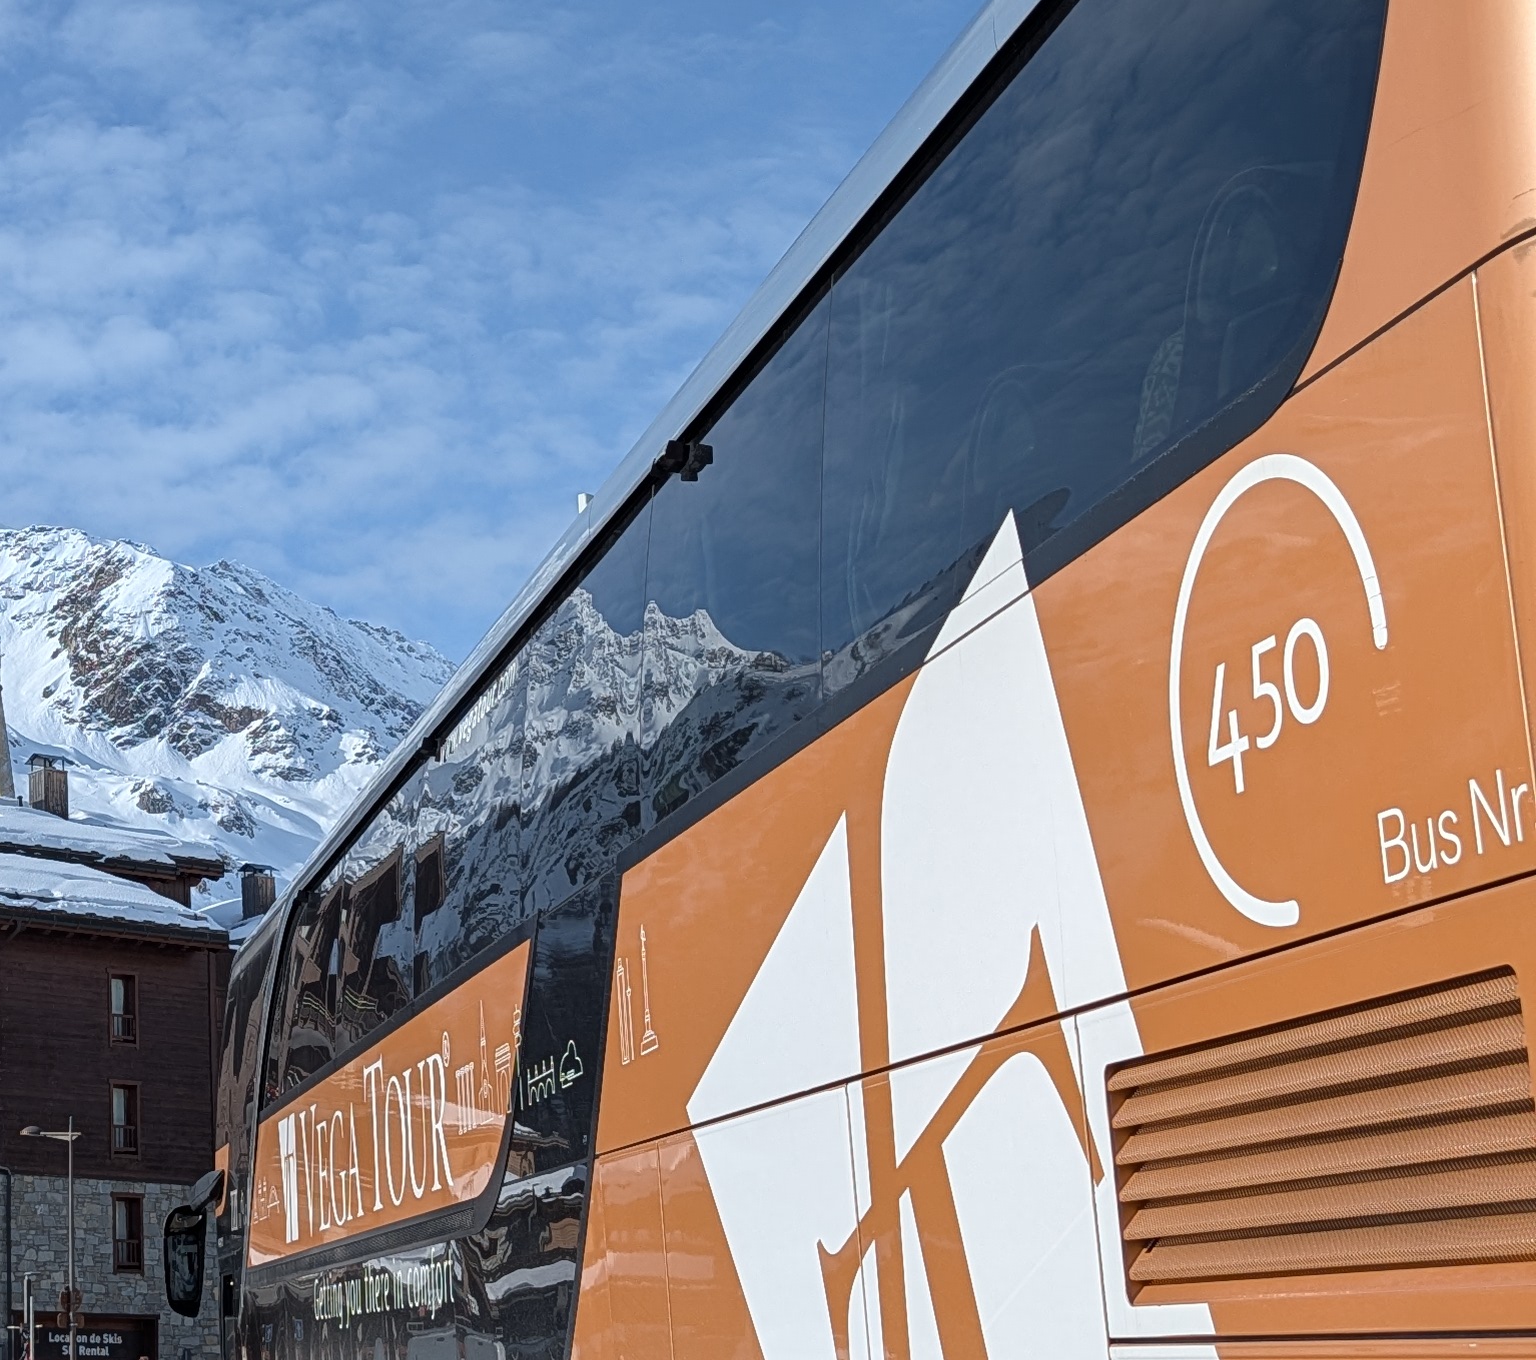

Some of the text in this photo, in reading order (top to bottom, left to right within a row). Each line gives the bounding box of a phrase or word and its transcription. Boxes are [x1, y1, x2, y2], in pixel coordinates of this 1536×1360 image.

[1207, 616, 1330, 795] 450
[1377, 807, 1462, 884] Bus
[298, 1101, 365, 1238] VEGA
[313, 1246, 455, 1330] Getting you there in comfort
[48, 1332, 123, 1345] Locaon de Skis
[78, 1345, 110, 1357] Rental
